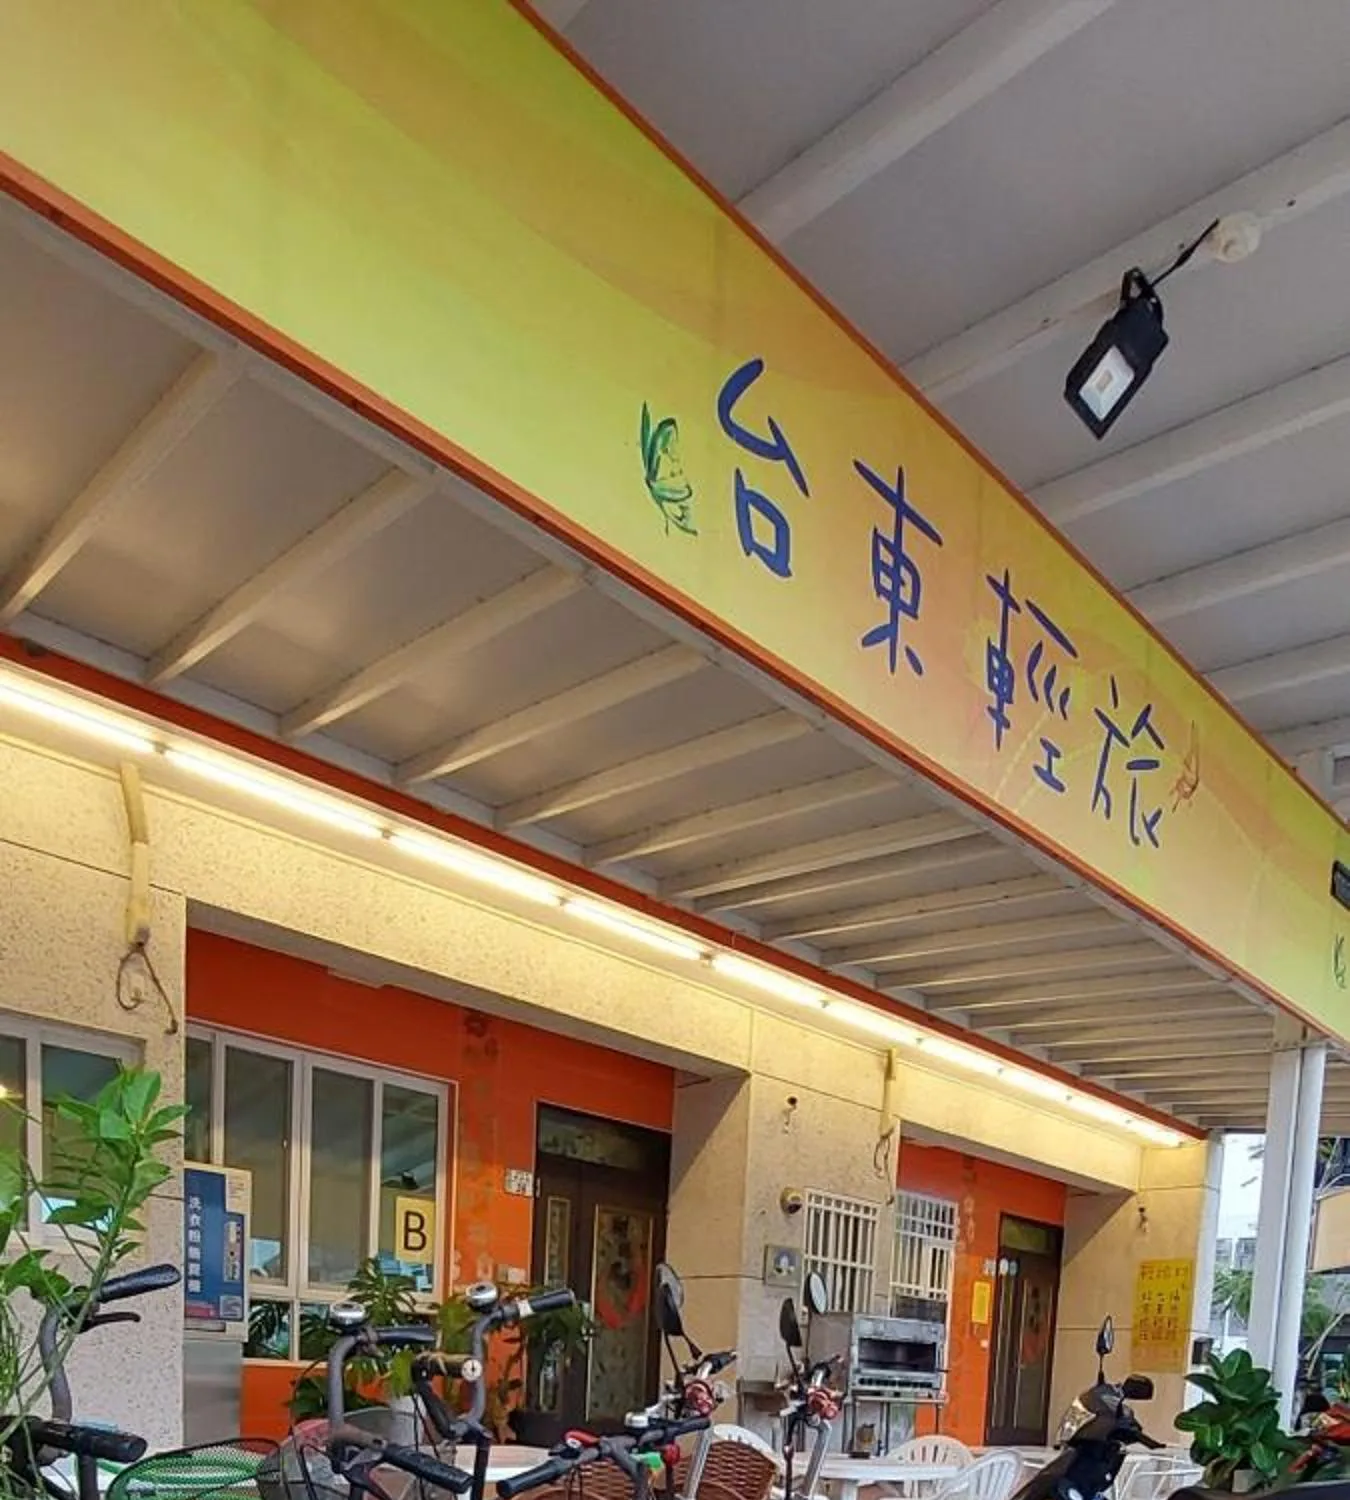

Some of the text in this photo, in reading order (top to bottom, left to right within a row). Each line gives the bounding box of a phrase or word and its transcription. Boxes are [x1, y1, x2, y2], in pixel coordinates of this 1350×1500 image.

[716, 357, 1165, 849] 台東輕旅
[403, 1210, 427, 1251] B
